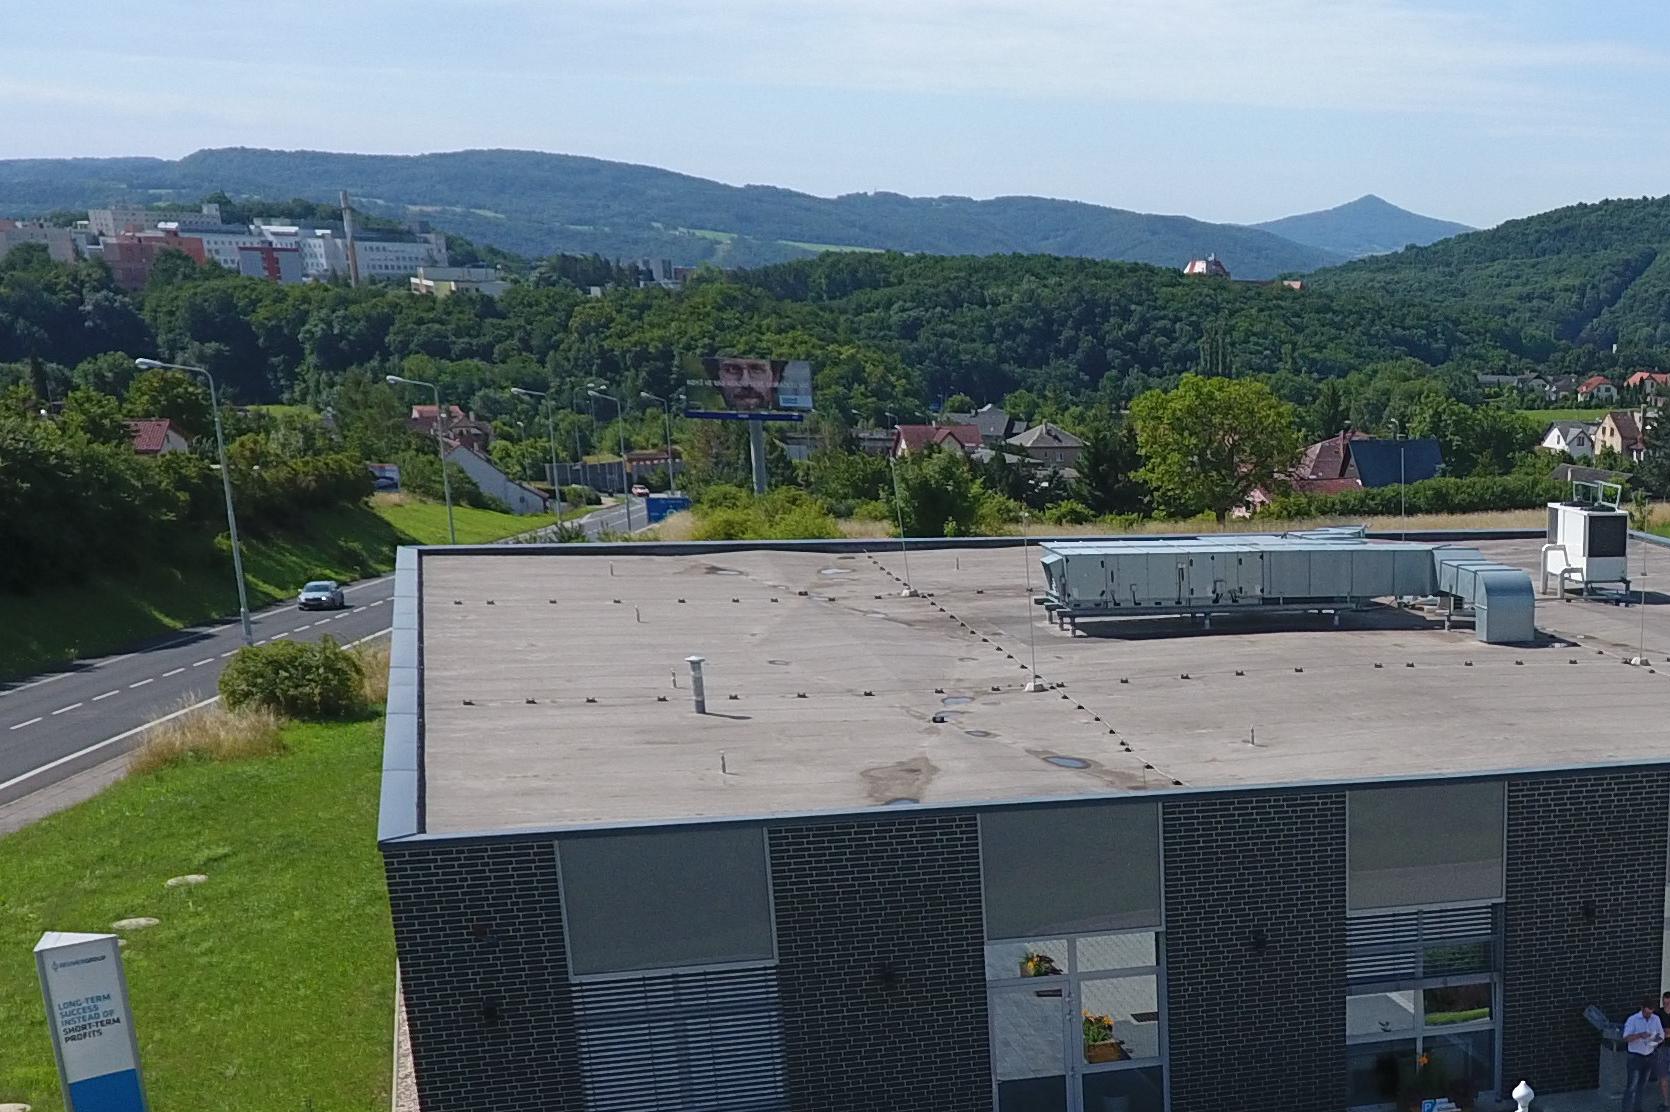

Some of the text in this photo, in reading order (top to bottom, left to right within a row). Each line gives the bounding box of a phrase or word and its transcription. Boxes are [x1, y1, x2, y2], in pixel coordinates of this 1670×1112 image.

[58, 993, 111, 1011] LONG-TERM
[60, 1004, 100, 1018] SUCCESS
[61, 1008, 114, 1026] INSTEAD OF
[63, 1017, 121, 1036] SHORT-TERM
[65, 1029, 103, 1043] PROFITS
